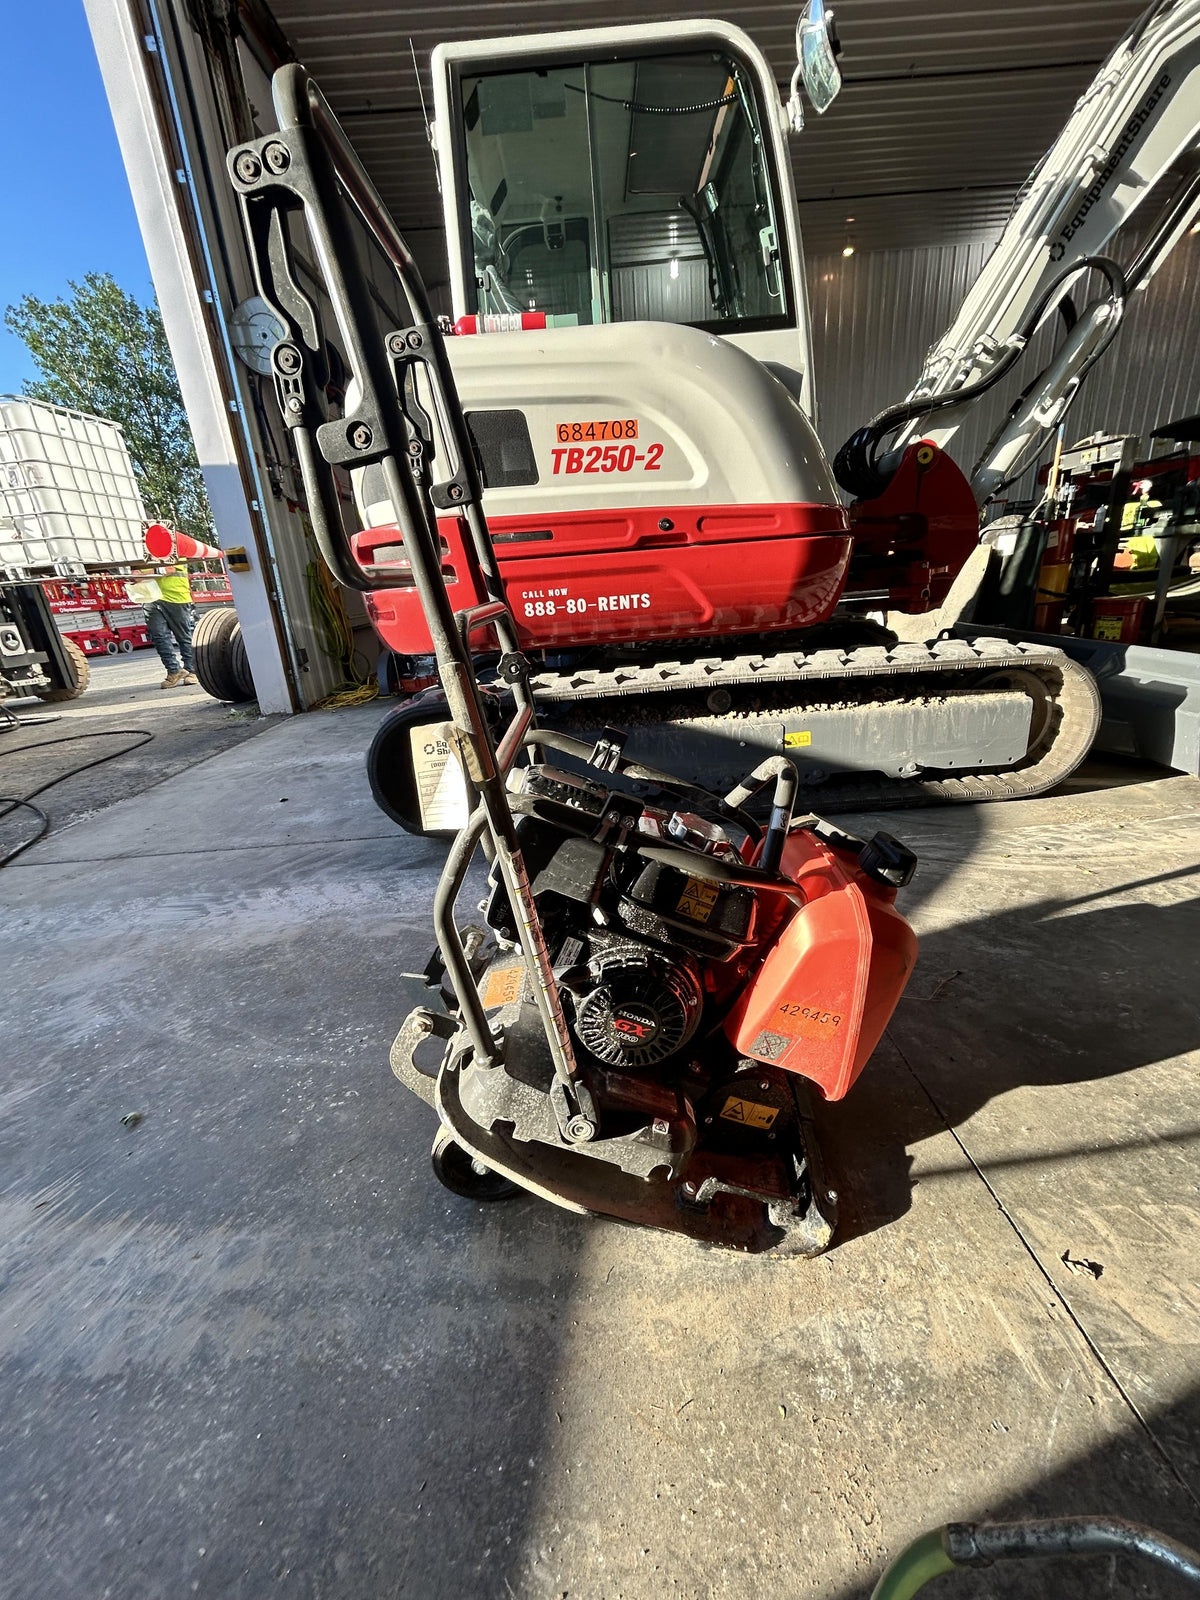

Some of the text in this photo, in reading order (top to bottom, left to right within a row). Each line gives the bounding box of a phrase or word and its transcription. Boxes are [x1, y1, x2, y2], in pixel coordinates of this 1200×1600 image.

[1060, 74, 1172, 243] EquipmentShare
[558, 420, 637, 442] 684708
[551, 443, 664, 475] TB250-2
[522, 588, 568, 599] CALL NOW
[524, 593, 651, 617] 888-80-RENTS
[618, 1010, 656, 1027] HONDA
[780, 1003, 841, 1027] 429459
[614, 1019, 652, 1038] GX
